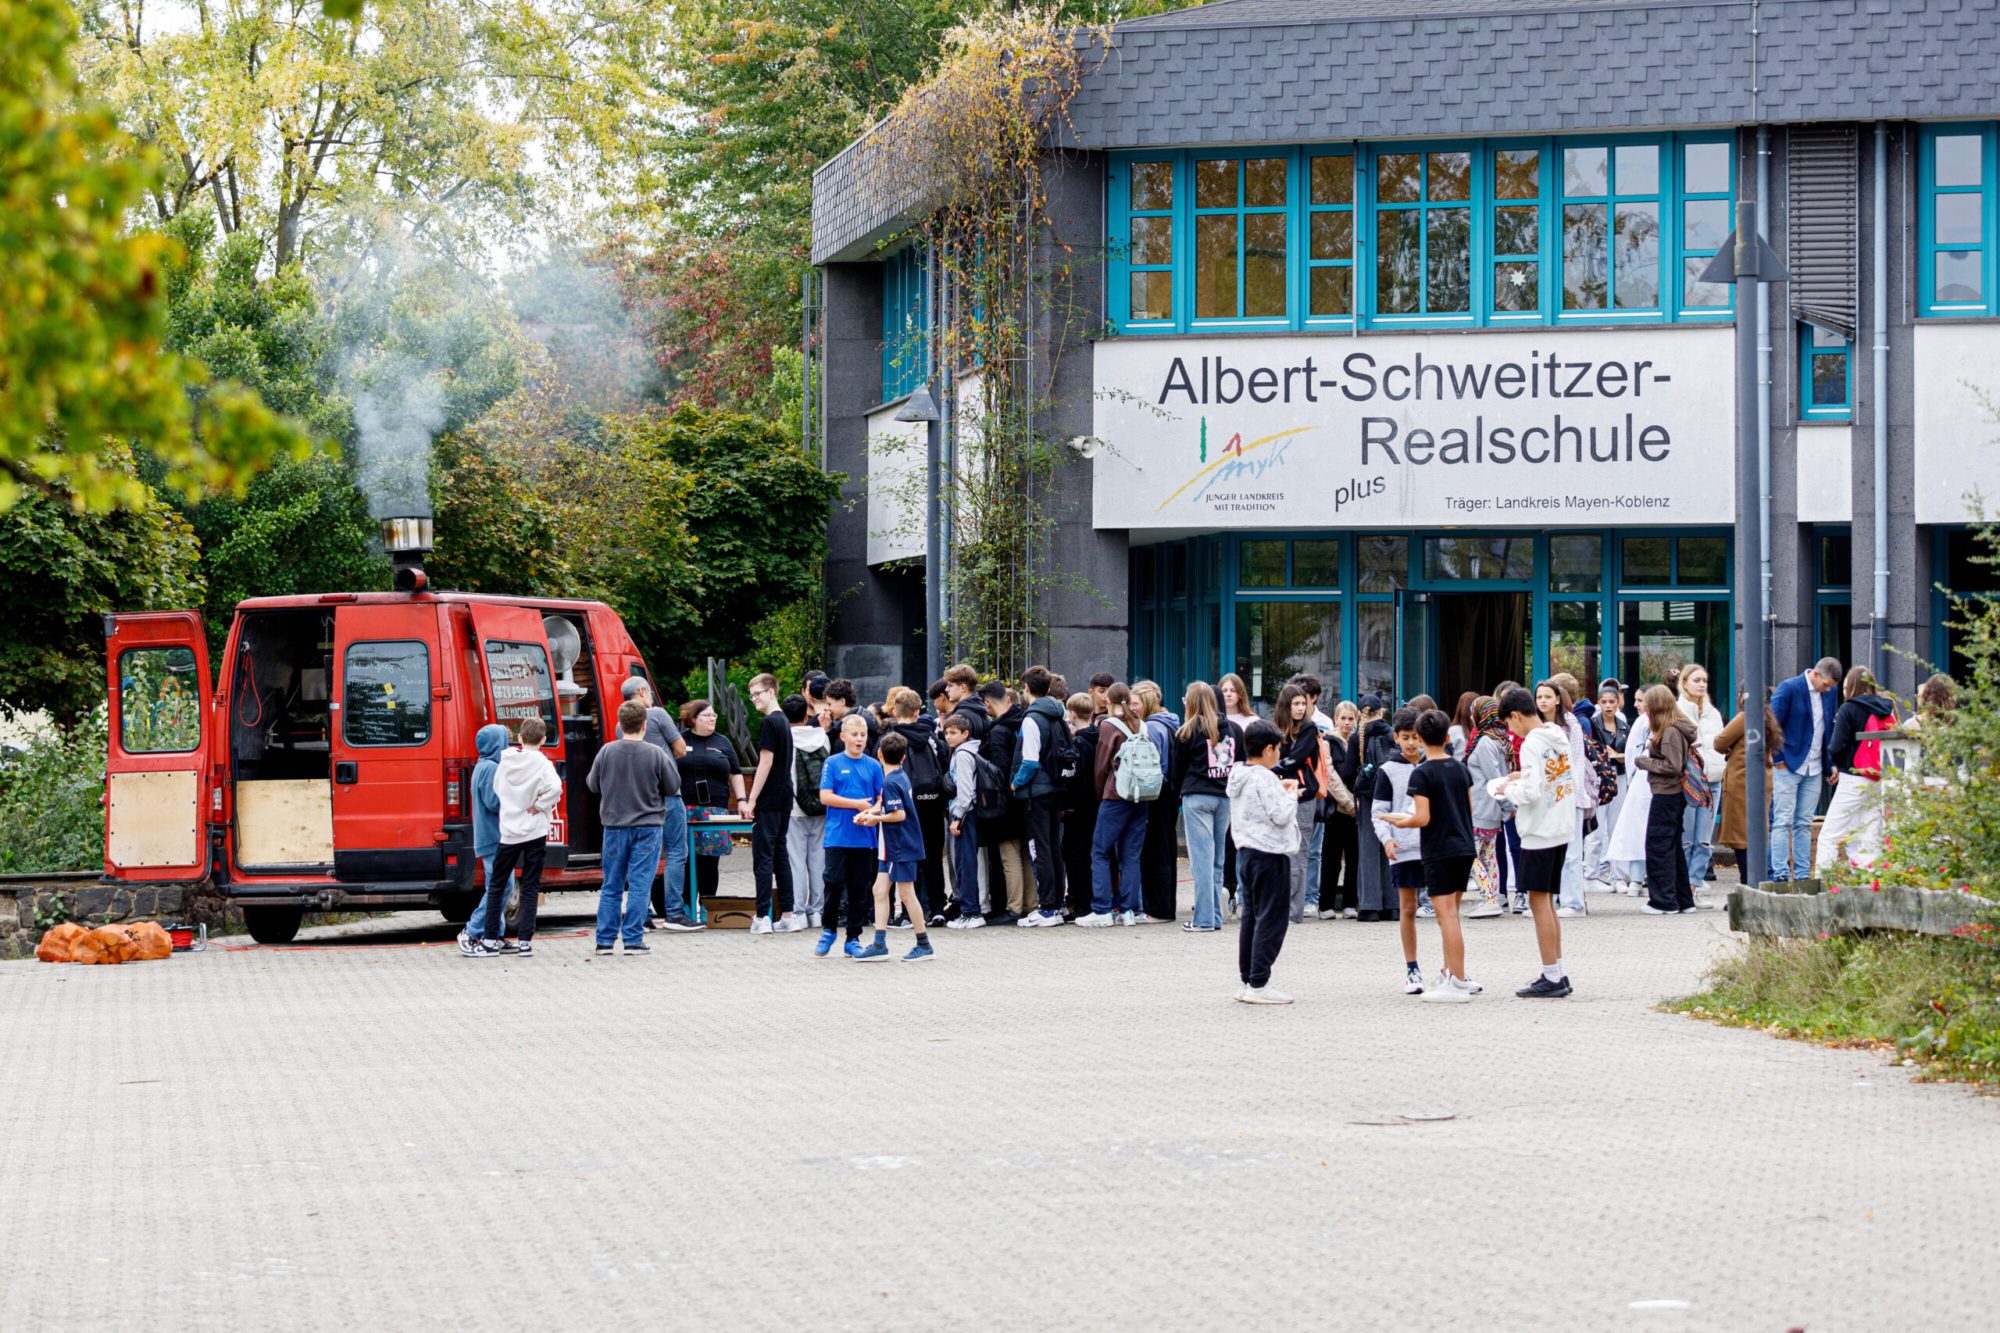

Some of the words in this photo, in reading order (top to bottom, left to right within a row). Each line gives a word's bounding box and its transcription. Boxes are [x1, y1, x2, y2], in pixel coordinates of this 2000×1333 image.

[1158, 350, 1671, 405] Albert-Schweitzer-
[1361, 414, 1671, 465] Realschule
[1206, 493, 1237, 503] JUNGER
[1239, 492, 1284, 501] LANDKREIS
[1231, 503, 1276, 511] TRADITION
[1335, 476, 1386, 512] plus
[1445, 496, 1491, 513] Träger:
[1496, 496, 1561, 509] Landkreis
[1565, 495, 1670, 512] Mayen-Koblenz
